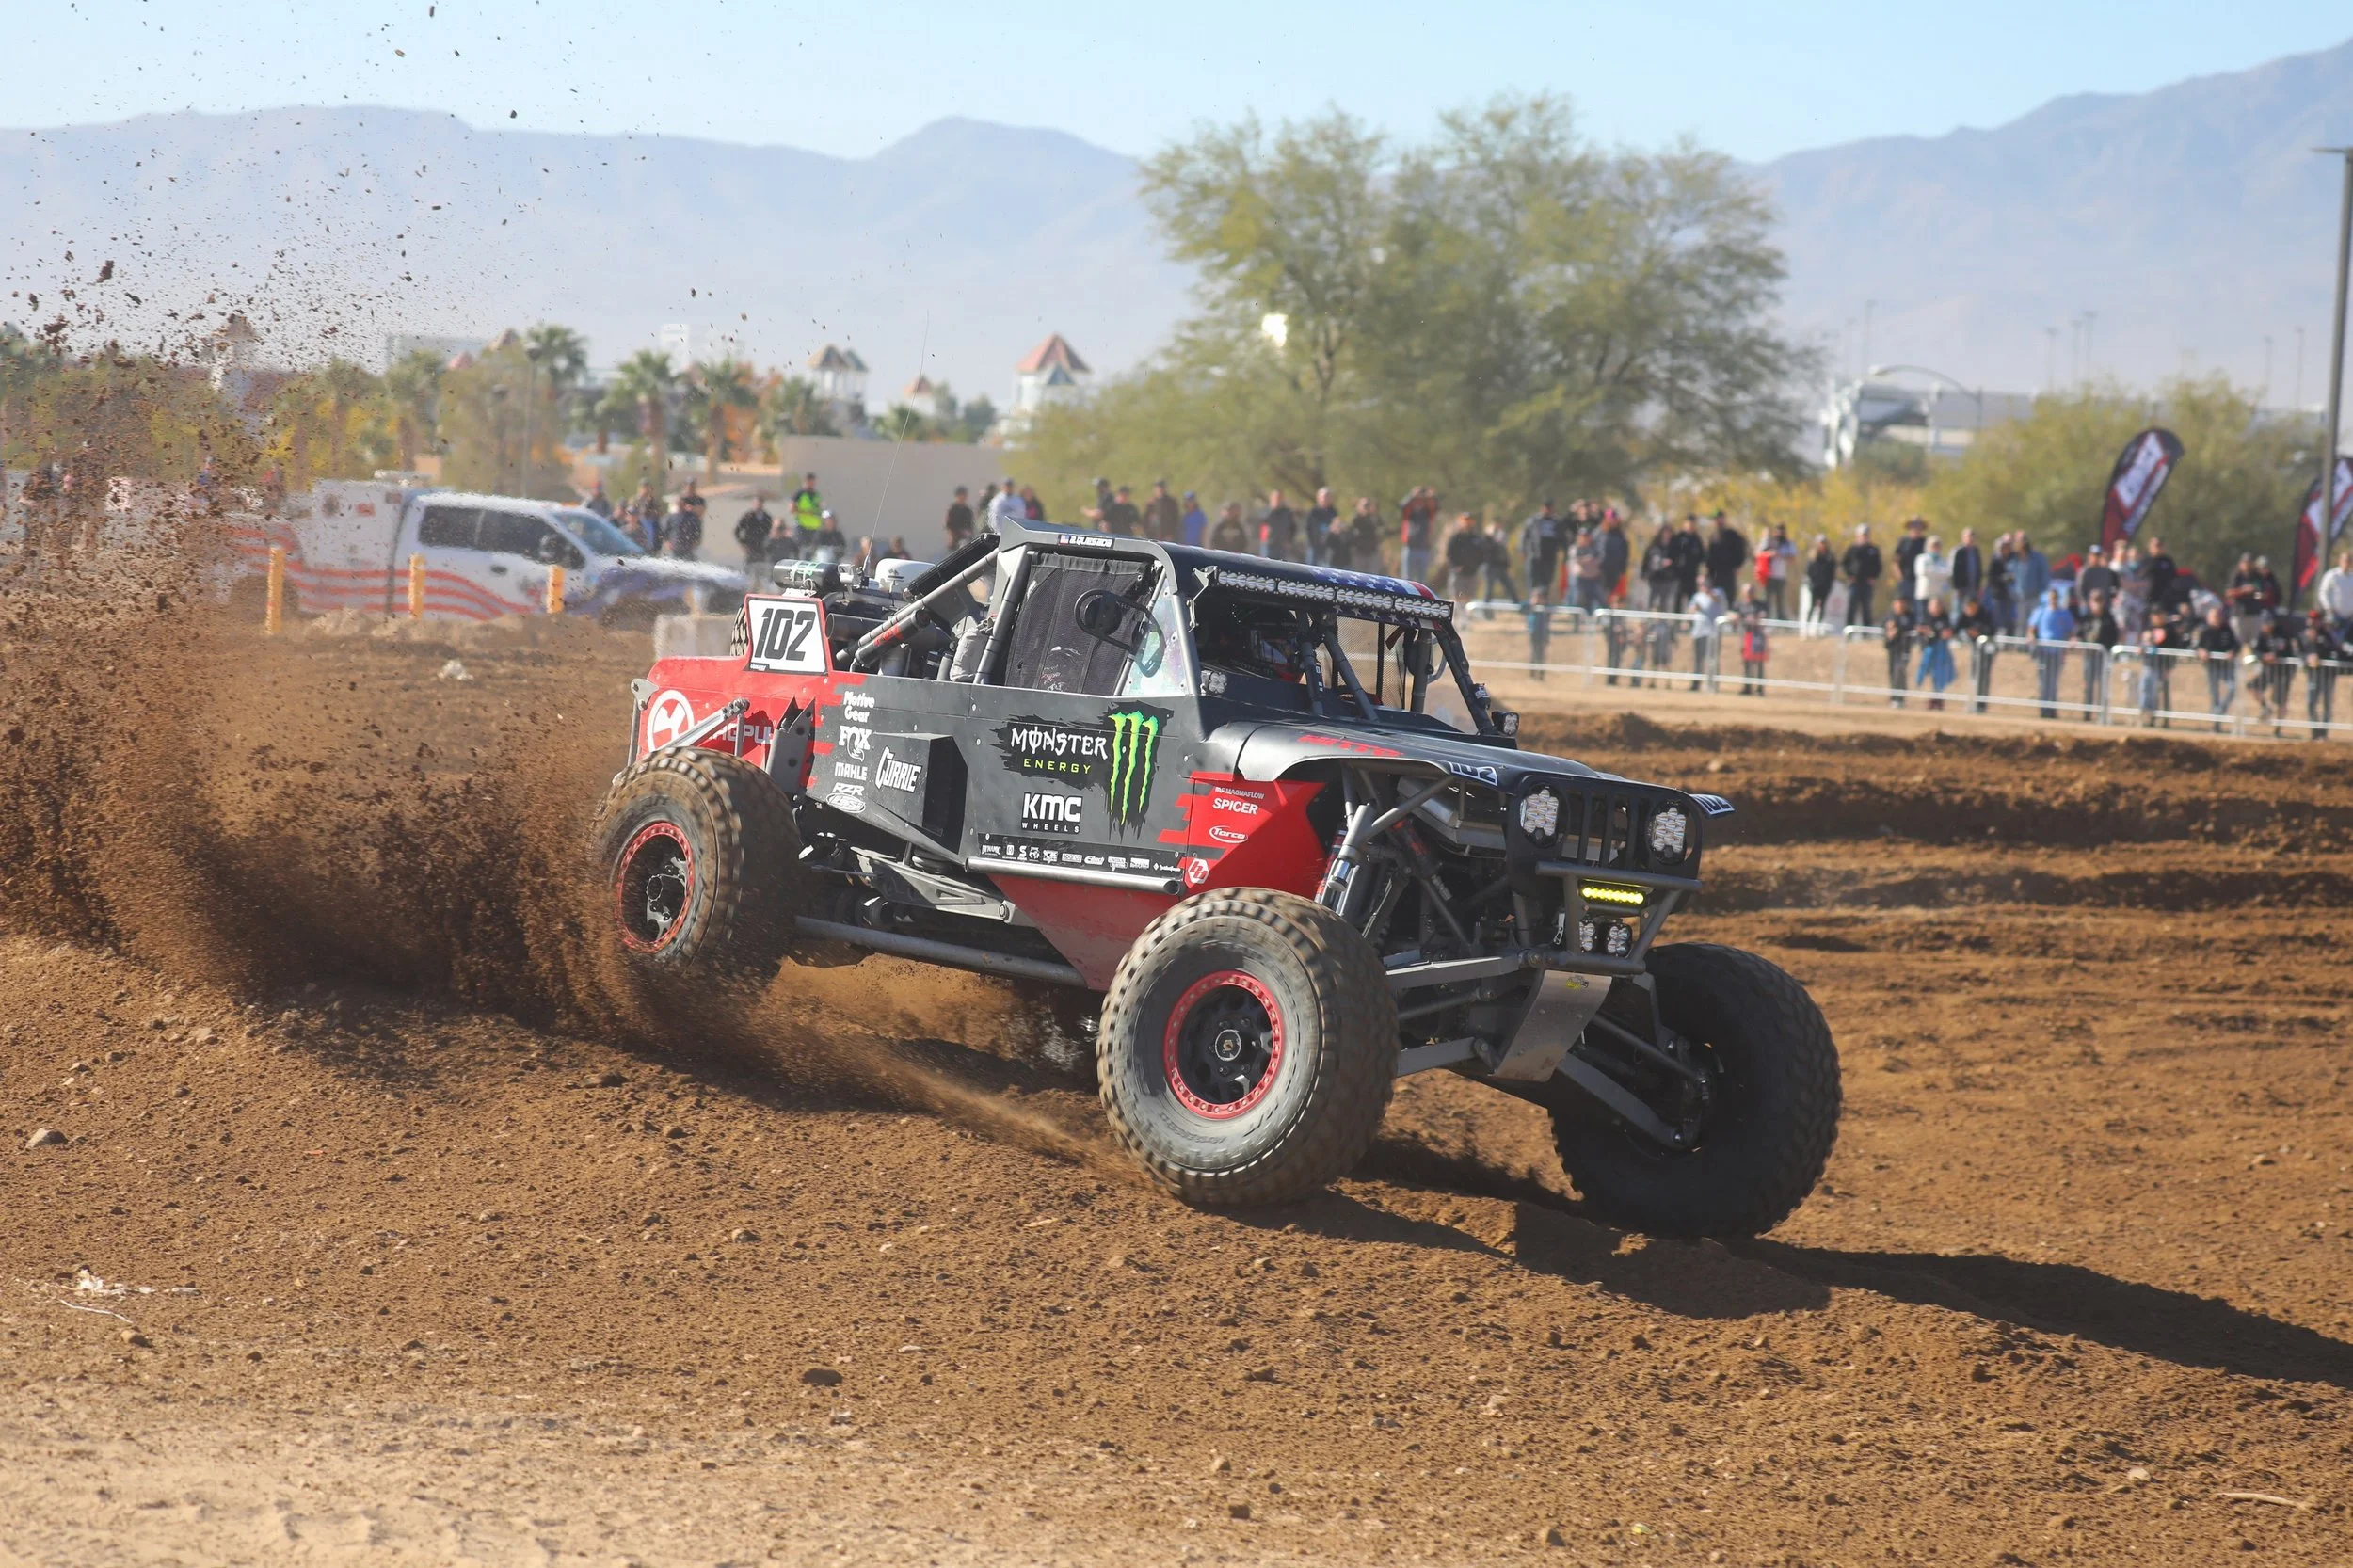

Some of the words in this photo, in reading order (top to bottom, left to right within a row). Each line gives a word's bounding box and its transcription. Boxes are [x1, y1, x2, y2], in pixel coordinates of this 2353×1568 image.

[754, 608, 816, 661] 102
[843, 691, 875, 708] Motive
[844, 705, 870, 723] Gear
[838, 725, 872, 759] FOX
[1011, 726, 1108, 760] MONSTER
[835, 762, 868, 781] MAHLE
[875, 746, 921, 792] CURRIE
[1024, 759, 1091, 774] ENERGY
[1022, 792, 1082, 823] KMC
[1213, 798, 1258, 815] SPICER
[1021, 822, 1080, 834] WHEELS
[1214, 827, 1246, 840] Torco
